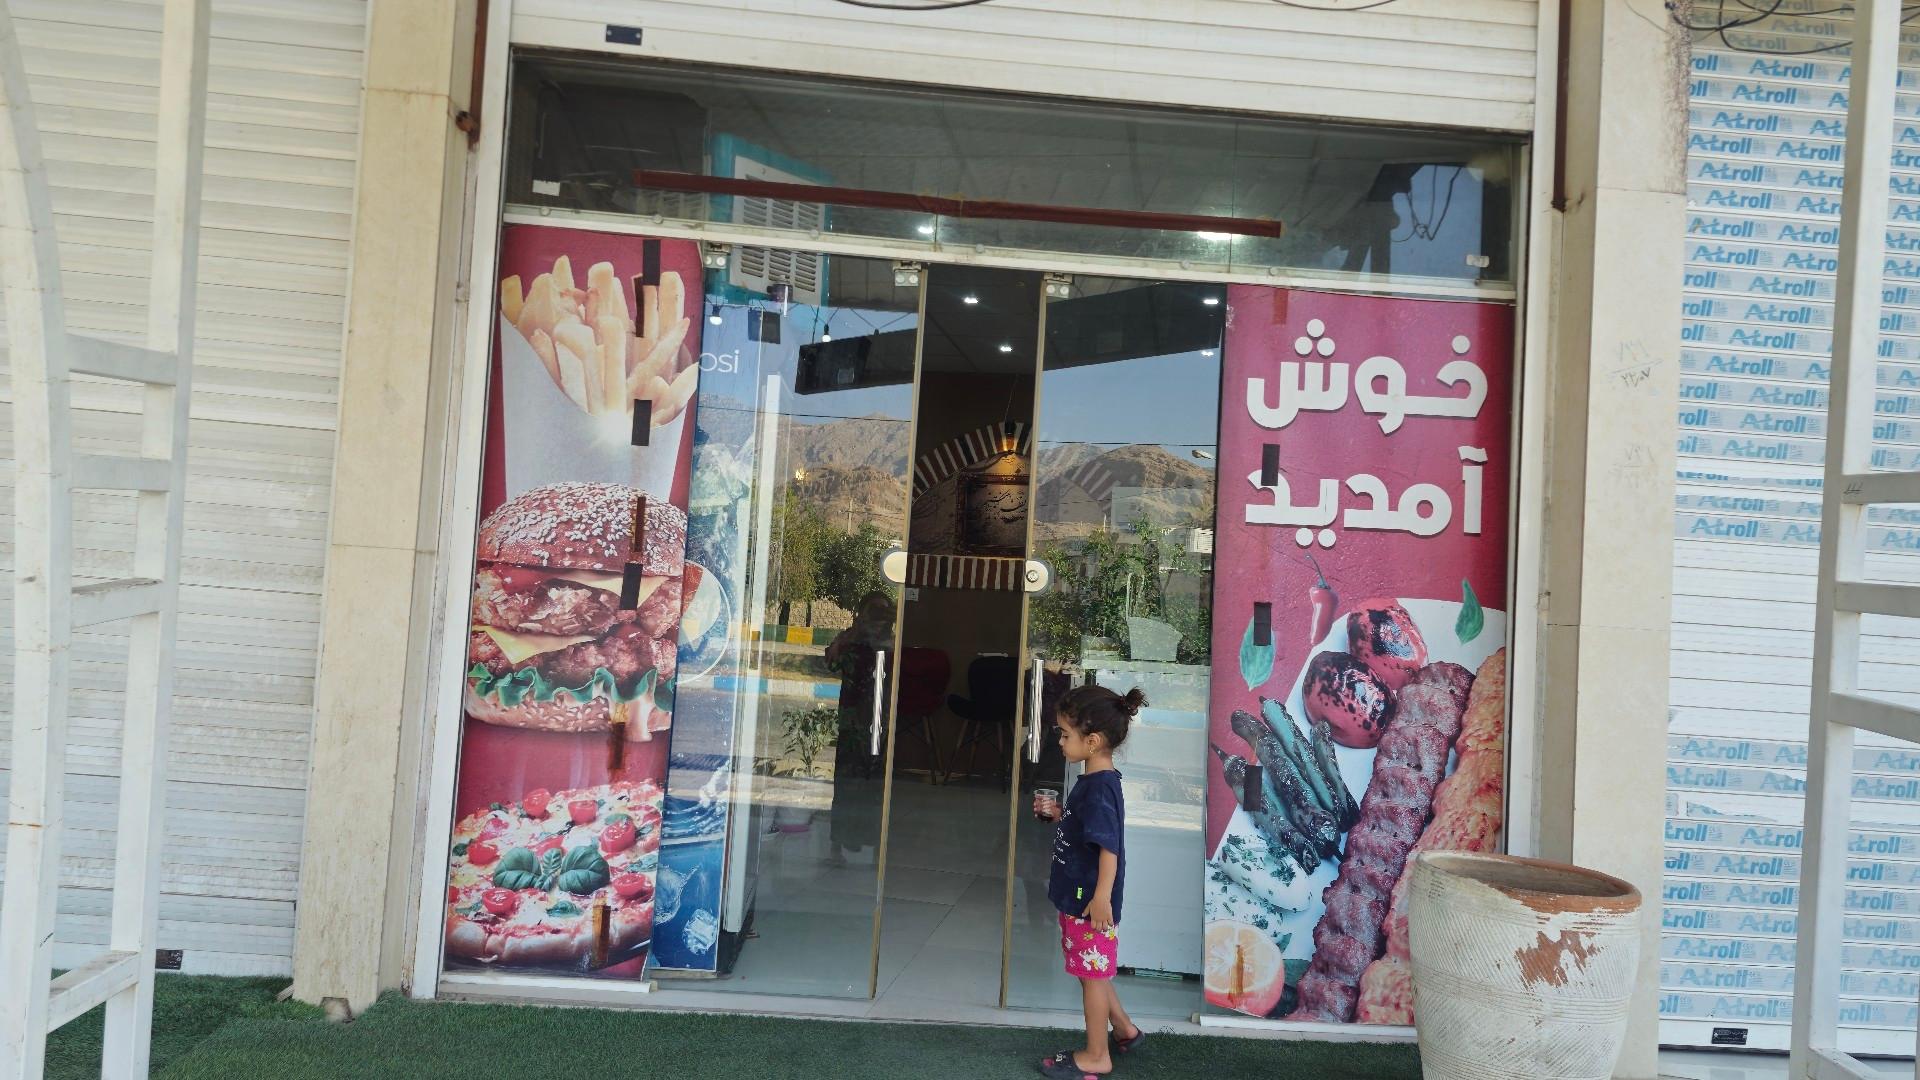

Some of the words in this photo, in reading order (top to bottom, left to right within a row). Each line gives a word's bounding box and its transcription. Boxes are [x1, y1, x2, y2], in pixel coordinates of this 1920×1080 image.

[1749, 58, 1815, 79] Atroll
[1731, 84, 1798, 105] Atroll
[1711, 111, 1779, 132] Atroll
[1687, 133, 1753, 154] Atroll
[1775, 141, 1841, 162] Atroll
[1697, 161, 1765, 182] Atroll
[1705, 189, 1773, 210] Atroll
[1687, 217, 1755, 238] Atroll
[1691, 245, 1760, 266] Atroll
[1783, 252, 1837, 272] Atro
[1684, 271, 1718, 289] roll
[1748, 276, 1817, 297] Atroll
[1744, 303, 1812, 324] Atroll
[1728, 328, 1796, 349] Atroll
[1247, 319, 1488, 433] خوش
[1705, 355, 1774, 376] Atroll
[1749, 386, 1817, 407] Atroll
[1739, 412, 1807, 433] Atroll
[1721, 439, 1789, 460] Atroll
[1246, 445, 1488, 548] آمدید
[1690, 516, 1759, 538] Atroll
[1681, 739, 1750, 760] Atroll
[1852, 778, 1918, 799] Atroll
[1740, 826, 1803, 848] Atrol
[1713, 855, 1784, 876] Atroll
[1726, 885, 1795, 906] Atroll
[1674, 938, 1742, 959] Atroll
[1680, 967, 1749, 988] Atroll
[1711, 997, 1780, 1018] Atroll
